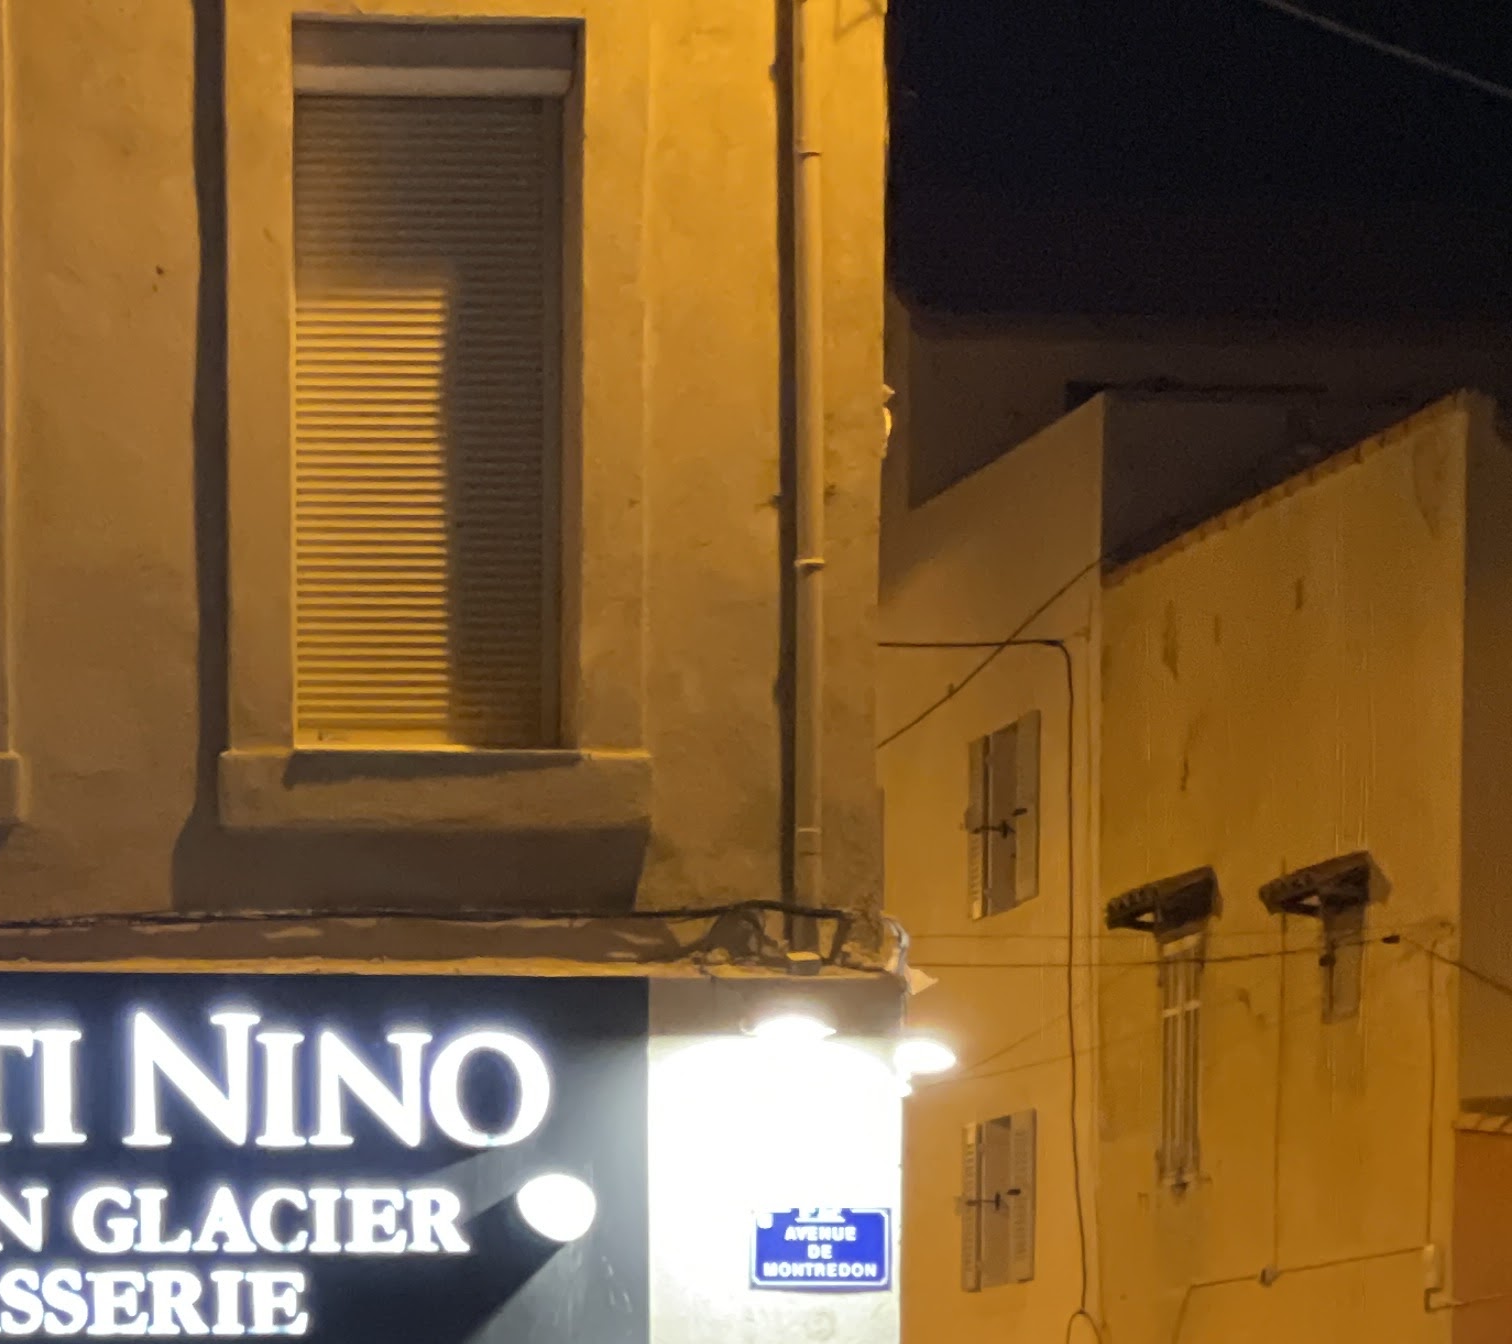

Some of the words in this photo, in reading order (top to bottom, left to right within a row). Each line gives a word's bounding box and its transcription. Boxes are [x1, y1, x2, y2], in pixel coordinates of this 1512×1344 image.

[123, 1009, 551, 1147] NINO
[71, 1185, 470, 1253] GLACIER
[784, 1225, 857, 1241] AVENUE
[807, 1244, 833, 1259] DE
[763, 1262, 877, 1278] MONTREDON
